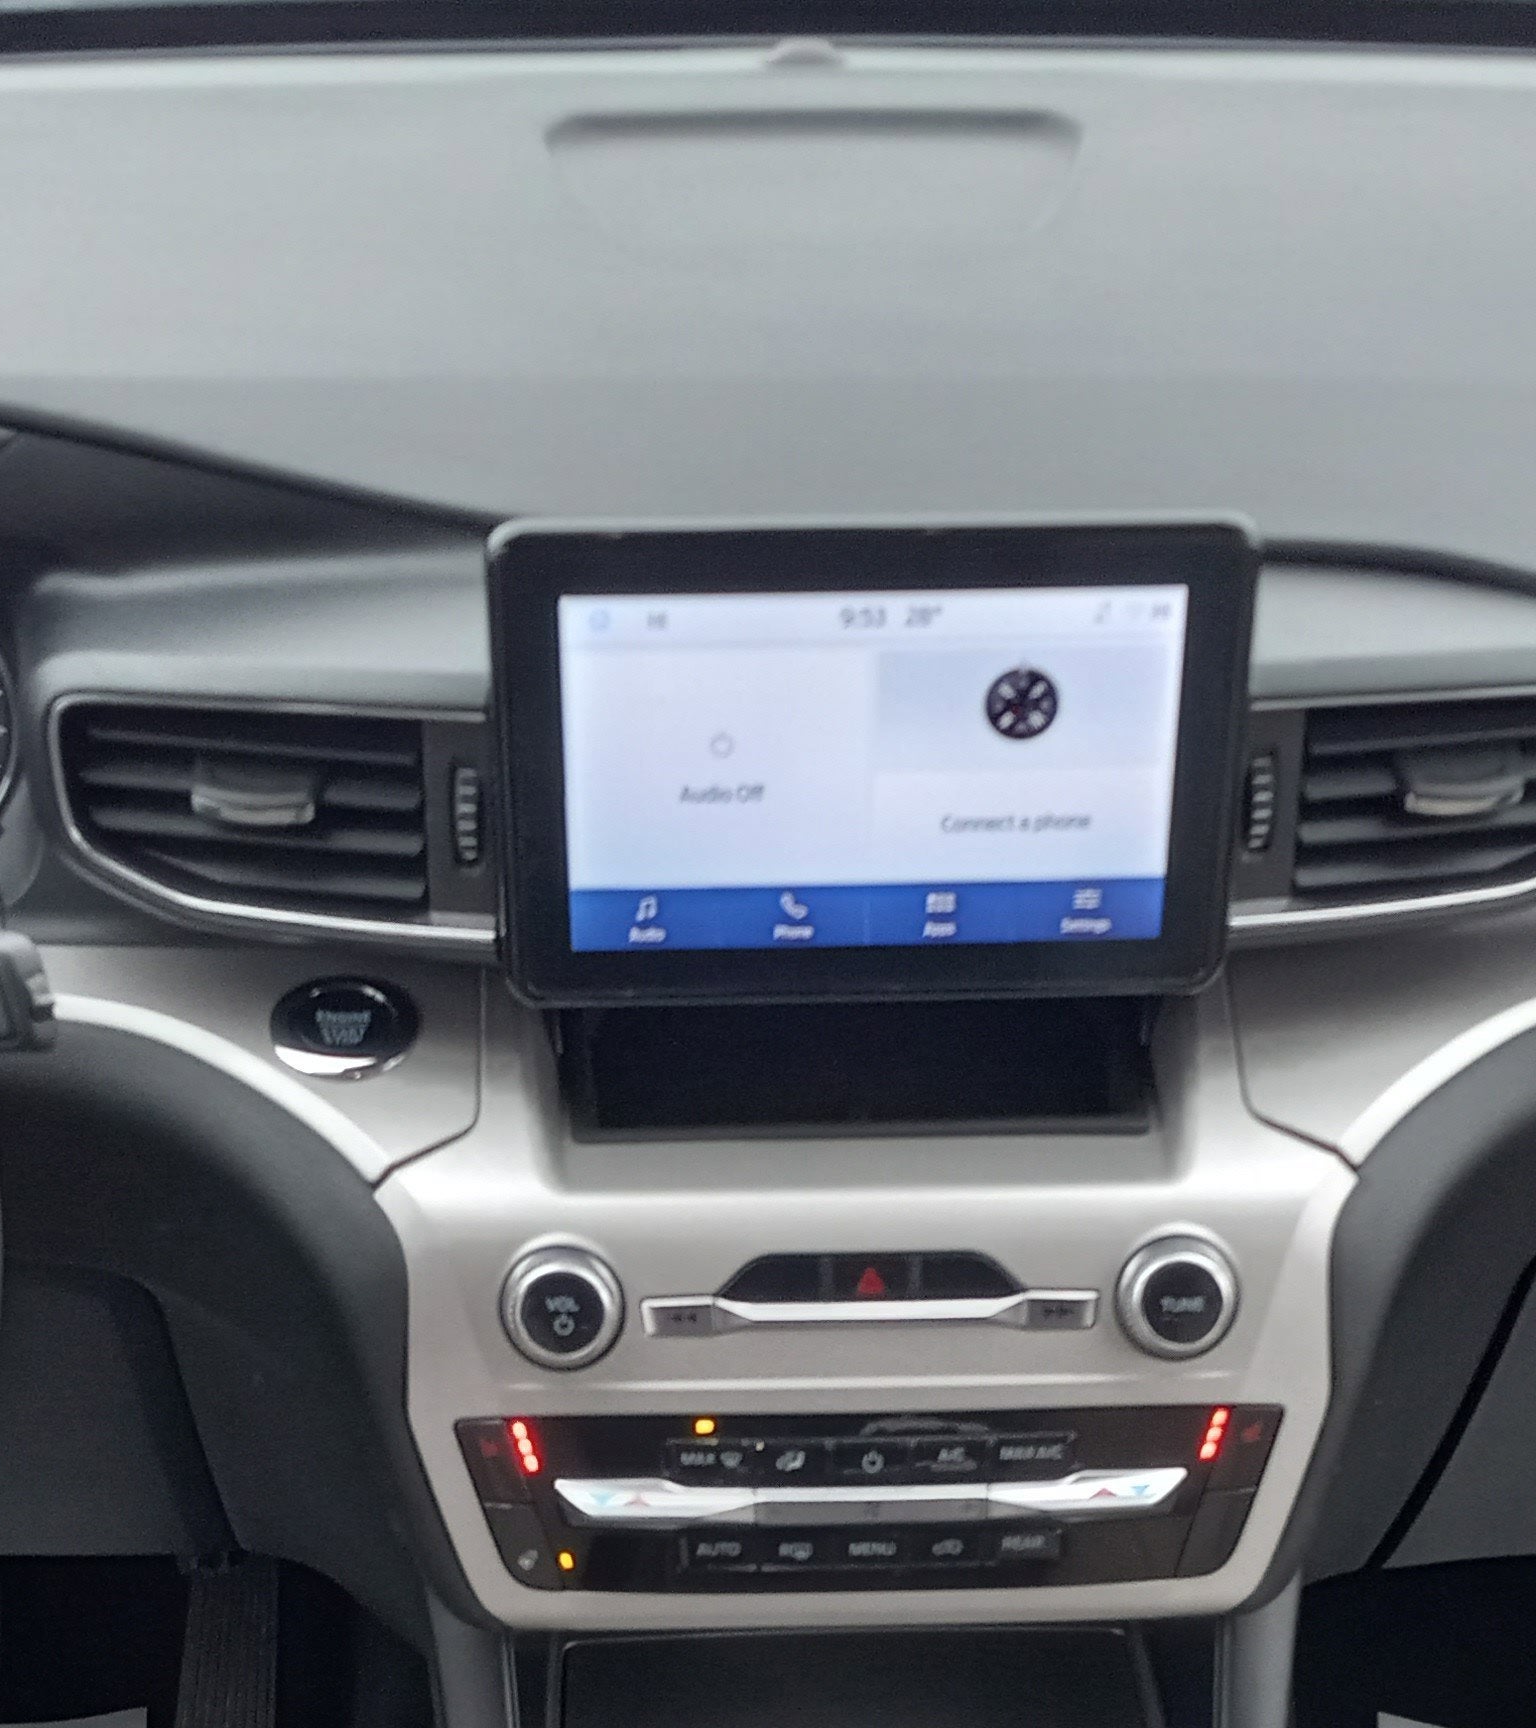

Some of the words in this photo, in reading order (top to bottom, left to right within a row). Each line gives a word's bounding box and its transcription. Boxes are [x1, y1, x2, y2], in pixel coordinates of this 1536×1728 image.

[679, 783, 733, 804] Audio
[940, 815, 1016, 833] Connect
[1033, 814, 1091, 834] phone
